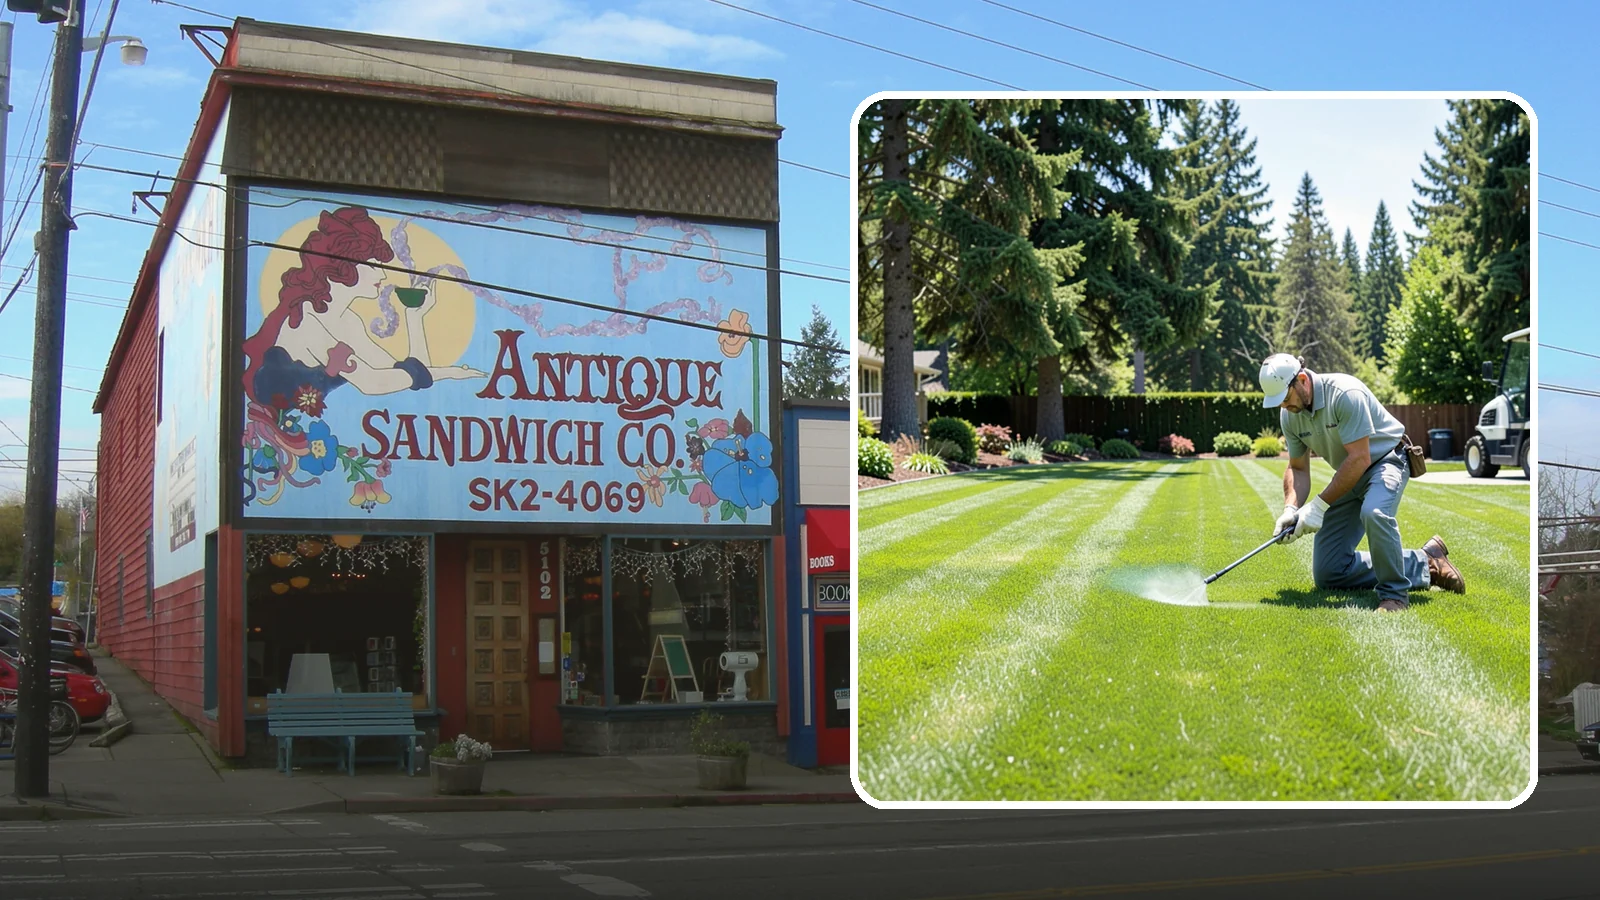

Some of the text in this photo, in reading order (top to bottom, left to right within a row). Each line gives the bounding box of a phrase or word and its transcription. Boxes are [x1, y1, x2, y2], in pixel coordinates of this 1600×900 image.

[477, 328, 724, 421] ANTIQUE
[361, 409, 685, 470] SANDWICH CO.
[468, 477, 646, 512] SK2-4069
[539, 541, 552, 599] 5102
[809, 555, 835, 569] BOOKS
